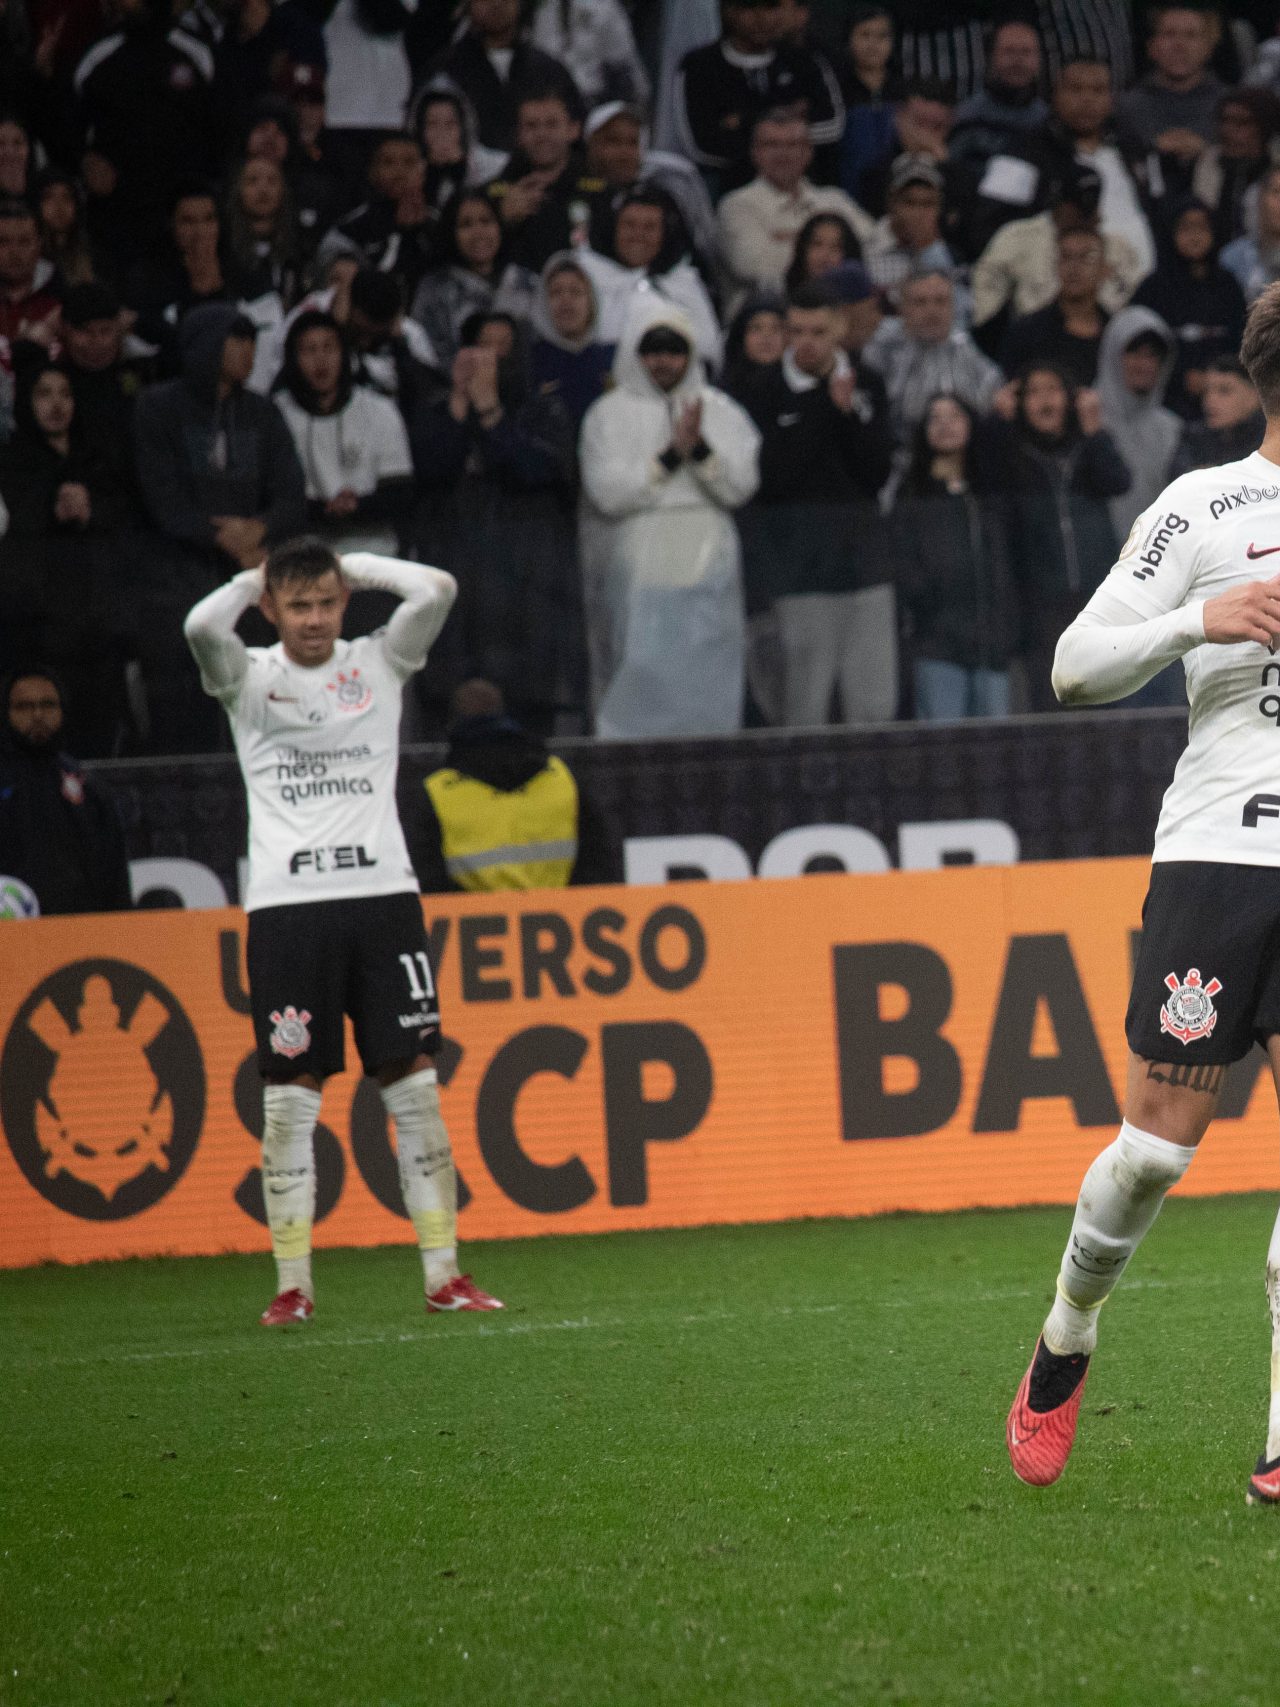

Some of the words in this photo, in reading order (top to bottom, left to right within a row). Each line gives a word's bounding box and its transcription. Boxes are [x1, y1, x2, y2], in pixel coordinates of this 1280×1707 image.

[1139, 512, 1190, 568] bmg
[278, 763, 327, 780] neo
[398, 951, 435, 1000] 11
